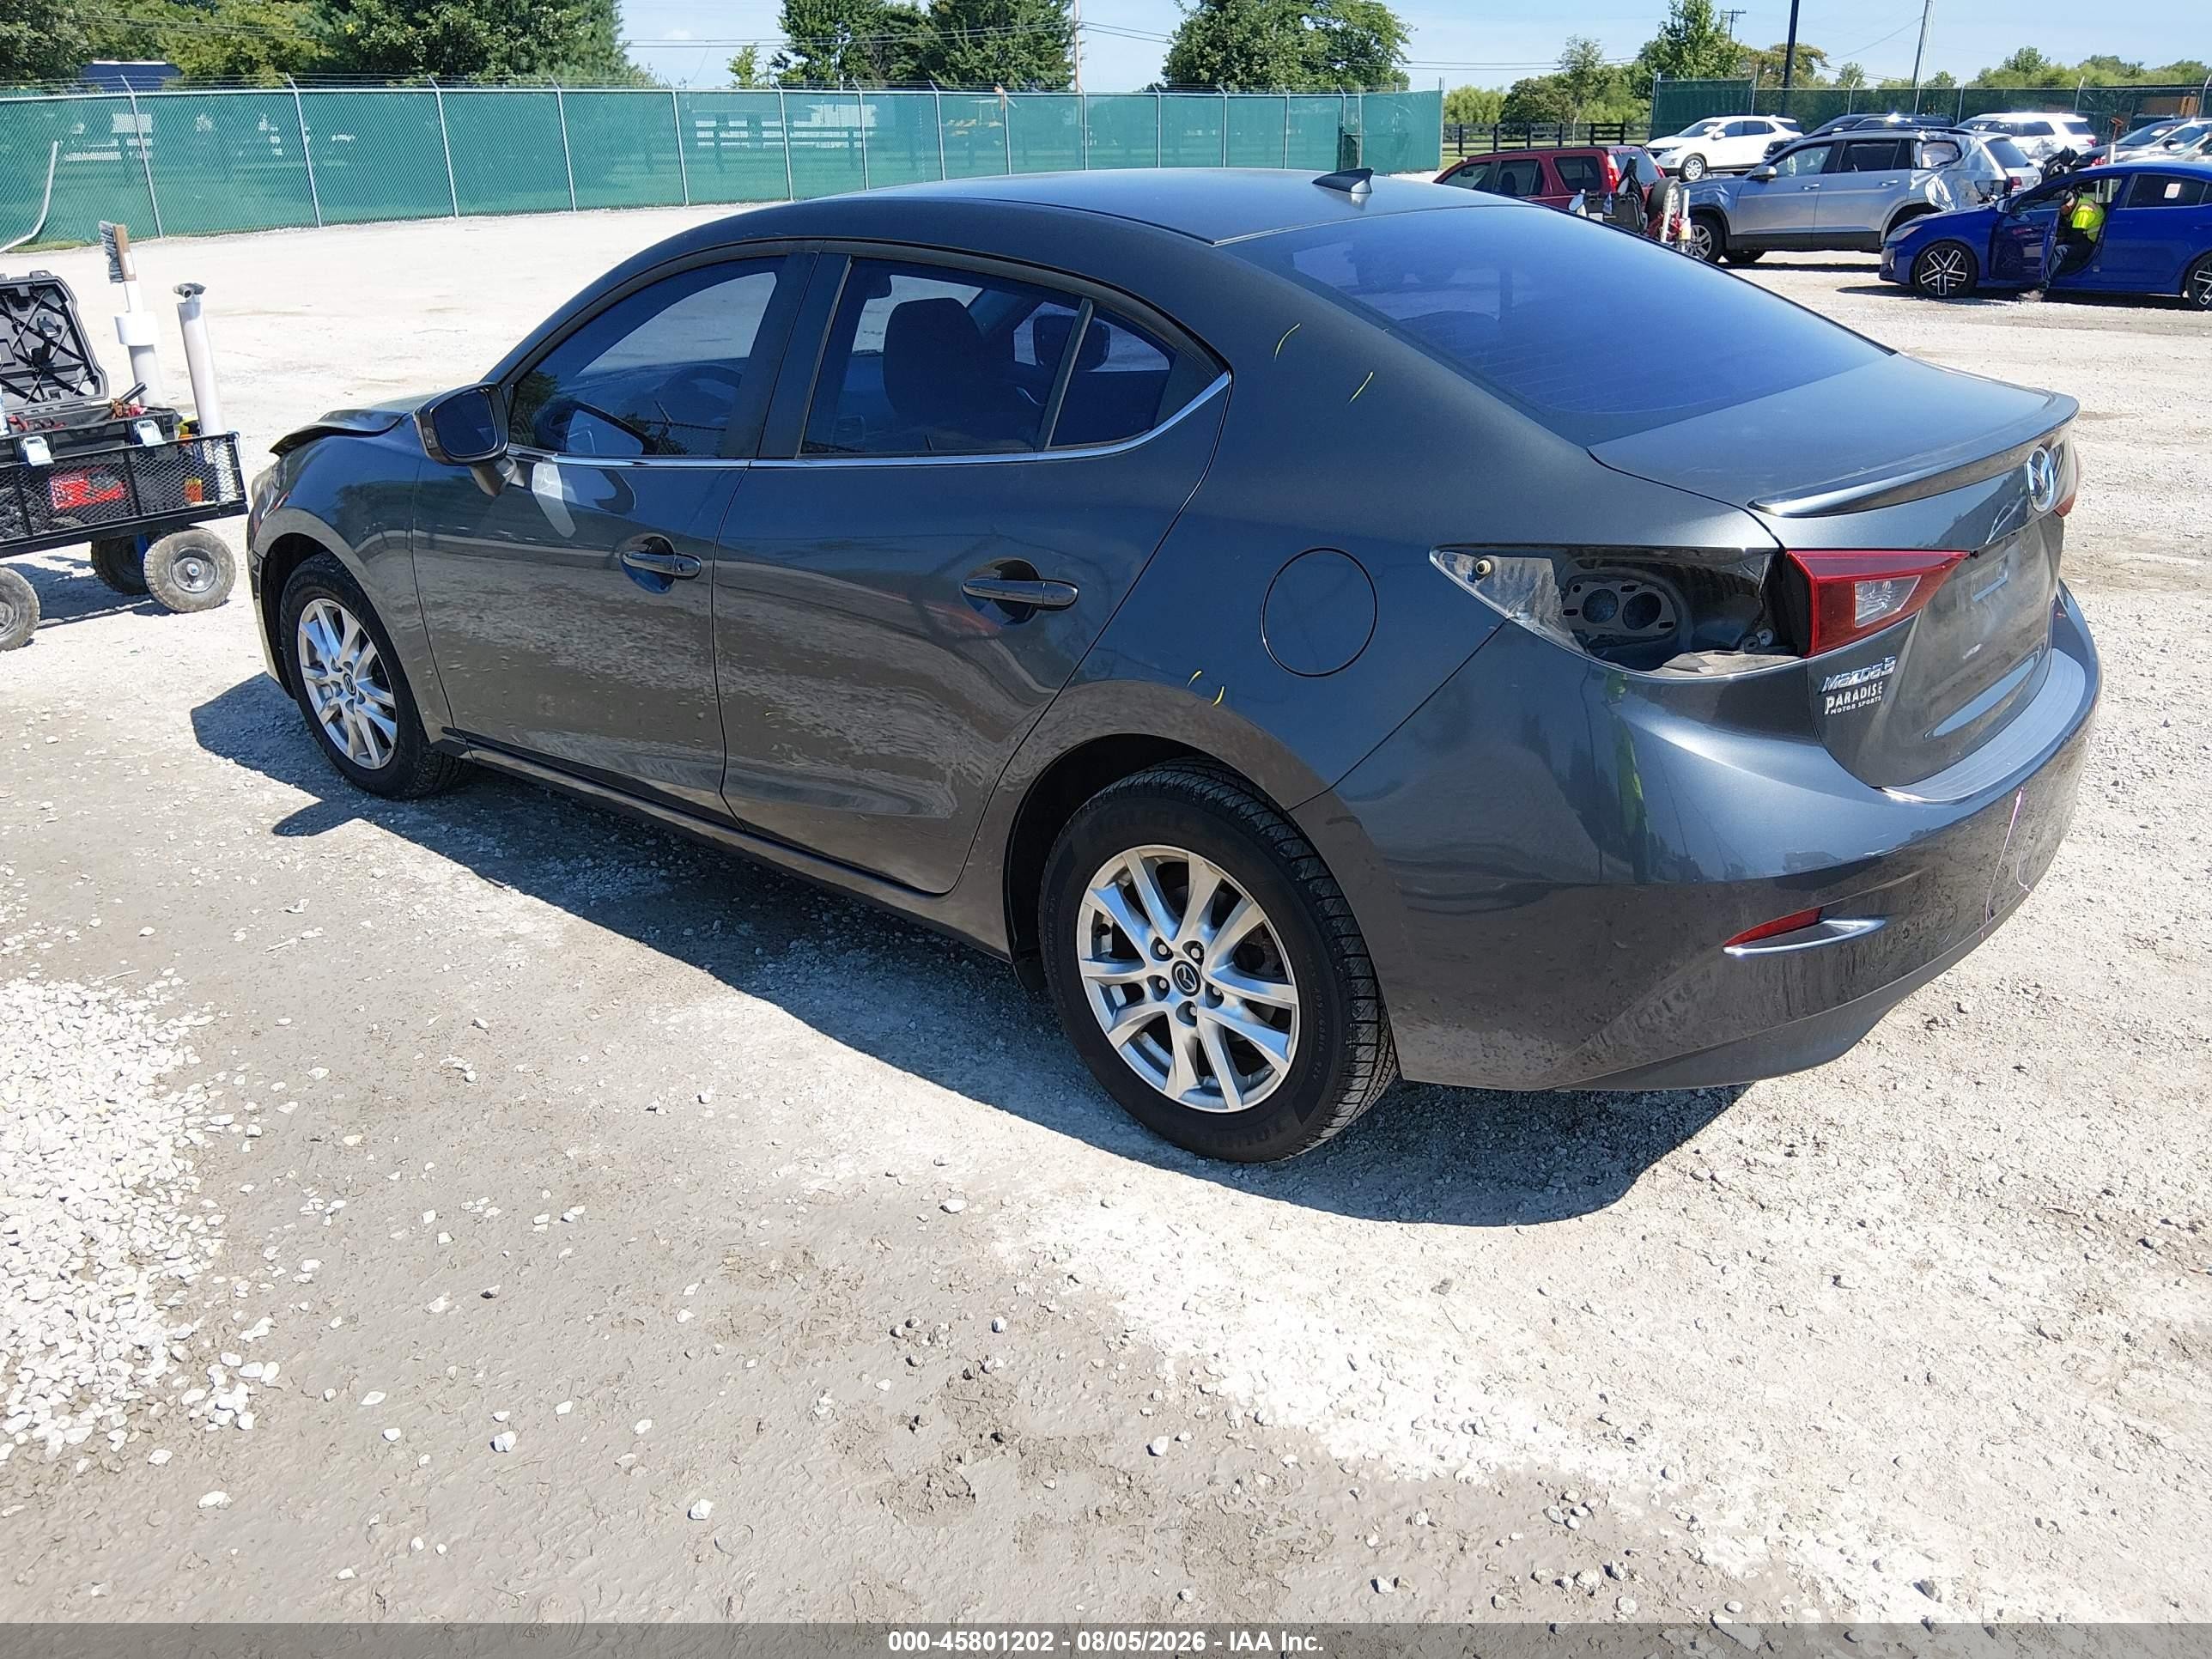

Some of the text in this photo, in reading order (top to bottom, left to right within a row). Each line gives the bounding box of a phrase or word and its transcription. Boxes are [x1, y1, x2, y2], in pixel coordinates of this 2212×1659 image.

[1824, 681, 1883, 715] PARADISE
[1830, 696, 1881, 715] MOTOR SPORTS
